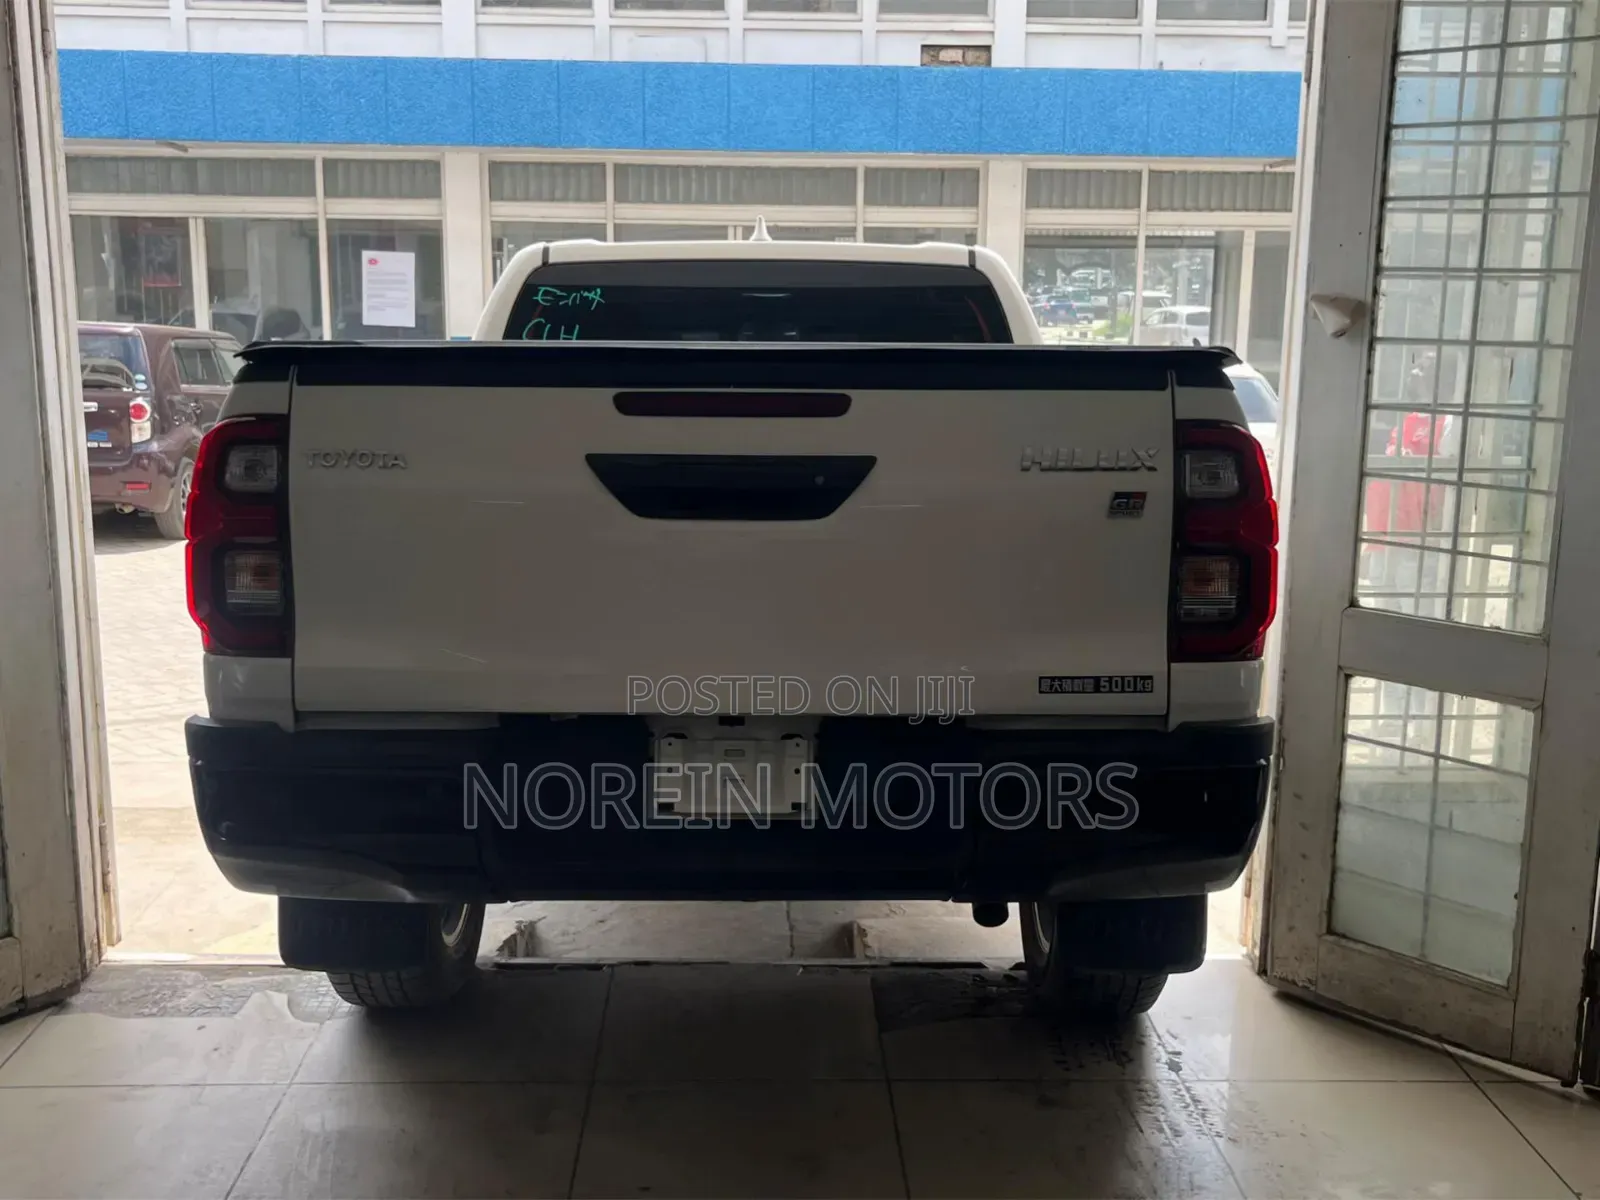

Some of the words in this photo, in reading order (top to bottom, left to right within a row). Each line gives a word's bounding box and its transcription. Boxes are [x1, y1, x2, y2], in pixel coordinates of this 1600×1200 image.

[305, 448, 408, 470] TOYOTA
[1021, 446, 1159, 472] HILUX
[1099, 677, 1152, 692] 500kg
